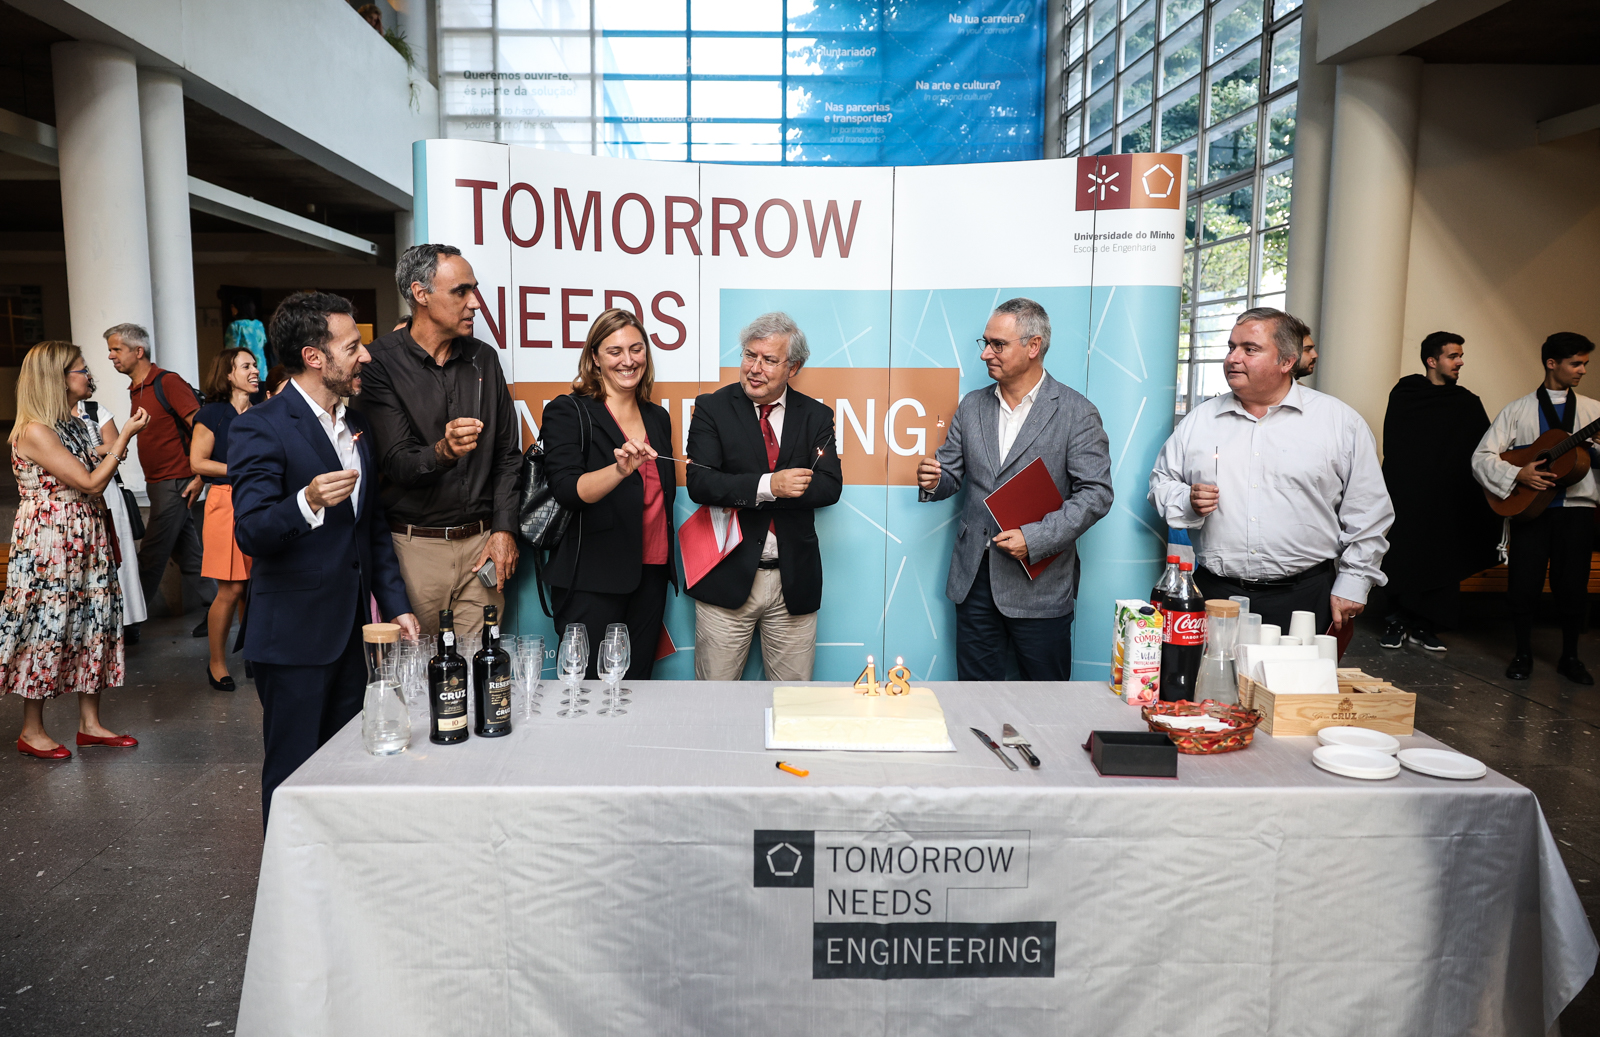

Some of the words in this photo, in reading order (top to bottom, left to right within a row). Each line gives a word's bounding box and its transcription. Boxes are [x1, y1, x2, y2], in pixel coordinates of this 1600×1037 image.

[948, 13, 962, 23] Na
[965, 14, 979, 24] tua
[982, 13, 1026, 24] carreira?
[813, 47, 877, 57] voluntariado?
[463, 70, 521, 80] Queremos
[463, 84, 477, 96] és
[481, 86, 510, 98] parte
[514, 85, 527, 96] da
[531, 84, 577, 98] solução!
[915, 81, 930, 90] Na
[932, 81, 952, 90] arte
[954, 82, 960, 90] e
[962, 80, 1001, 90] cultura?
[825, 102, 844, 112] Nas
[846, 102, 890, 114] parcerias
[824, 115, 830, 123] e
[833, 112, 893, 125] transportes?
[455, 178, 862, 259] TOMORROW
[1074, 231, 1133, 241] Universidade
[1135, 231, 1147, 239] do
[1149, 231, 1176, 240] Minho
[1073, 244, 1099, 254] Escola
[1100, 244, 1110, 253] de
[1112, 244, 1157, 254] Engenharia
[439, 689, 467, 701] CRUZ
[1331, 712, 1358, 720] CRUZ
[826, 846, 1014, 874] TOMORROW
[828, 888, 932, 916] NEEDS
[827, 936, 1041, 965] ENGINEERING
